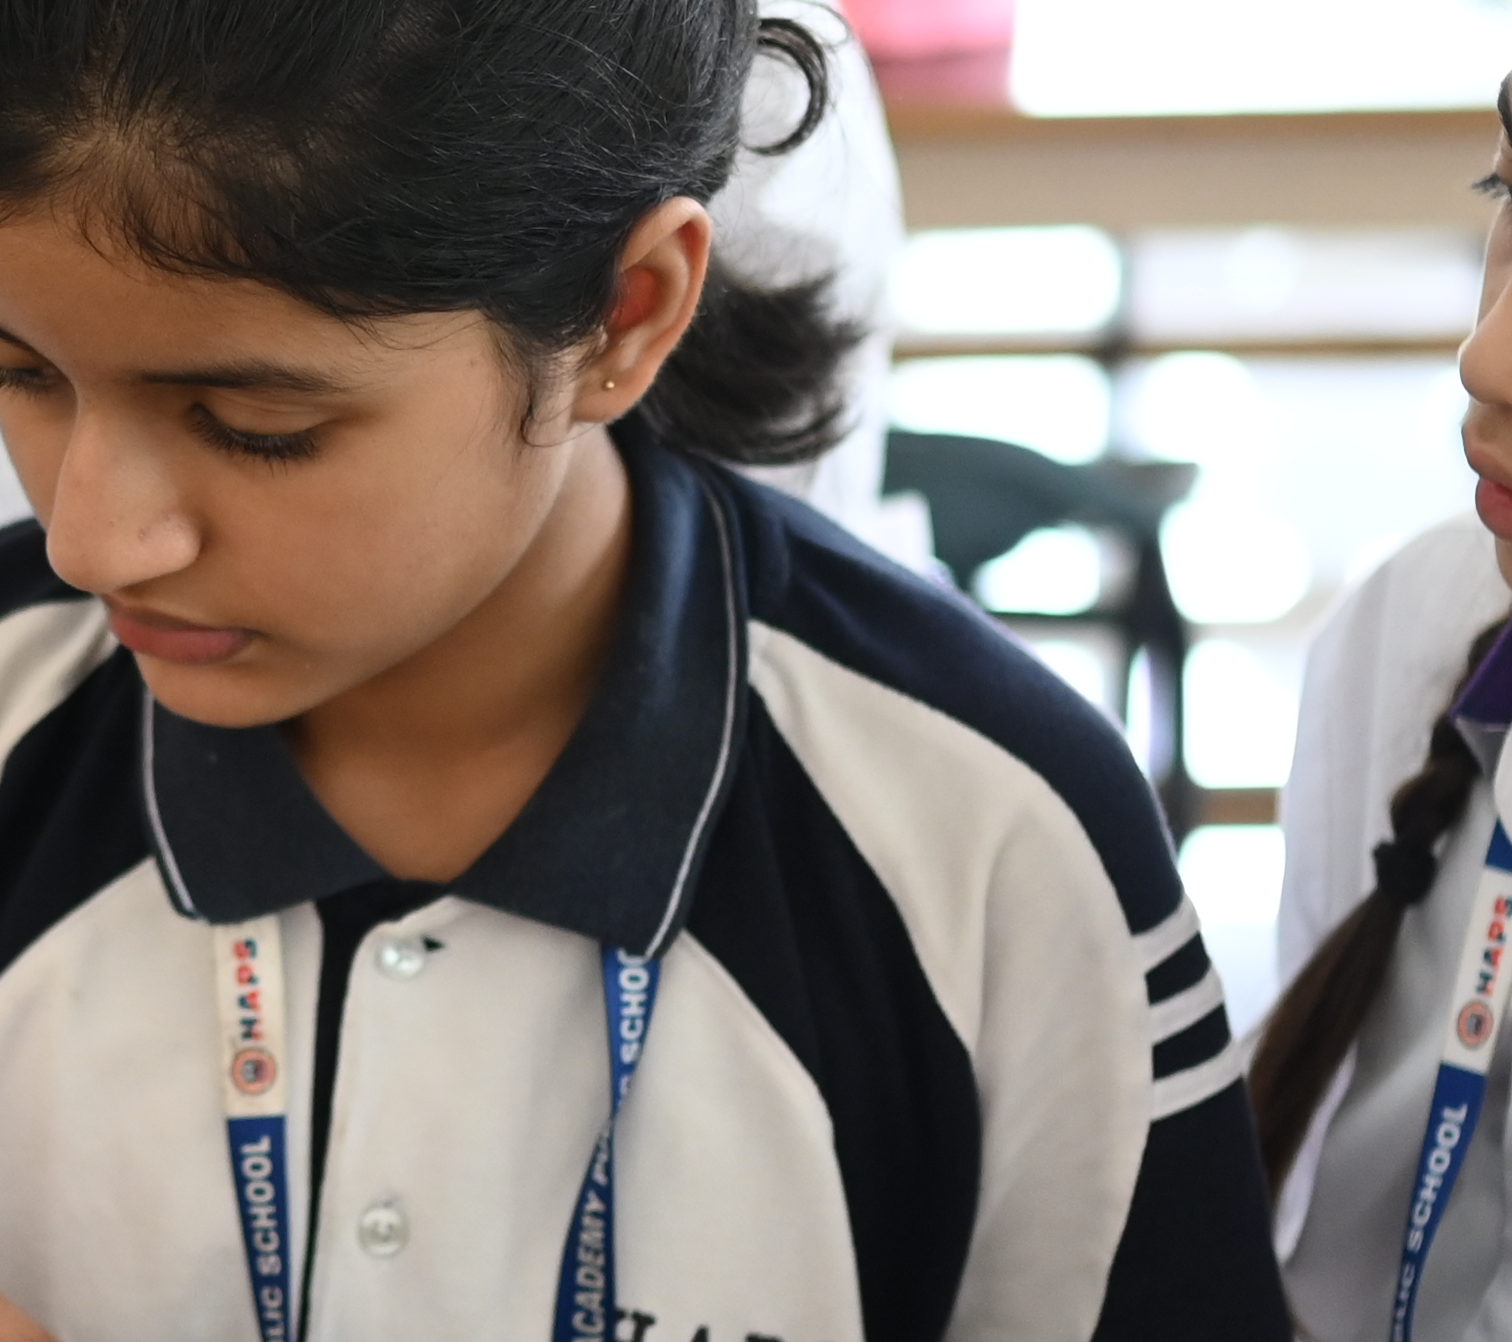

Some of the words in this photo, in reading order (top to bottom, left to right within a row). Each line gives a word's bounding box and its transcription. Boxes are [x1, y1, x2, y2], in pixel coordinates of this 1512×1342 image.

[233, 934, 261, 1042] HAPS
[240, 1136, 280, 1278] SCHOOL
[1406, 1101, 1469, 1254] SCHOOL
